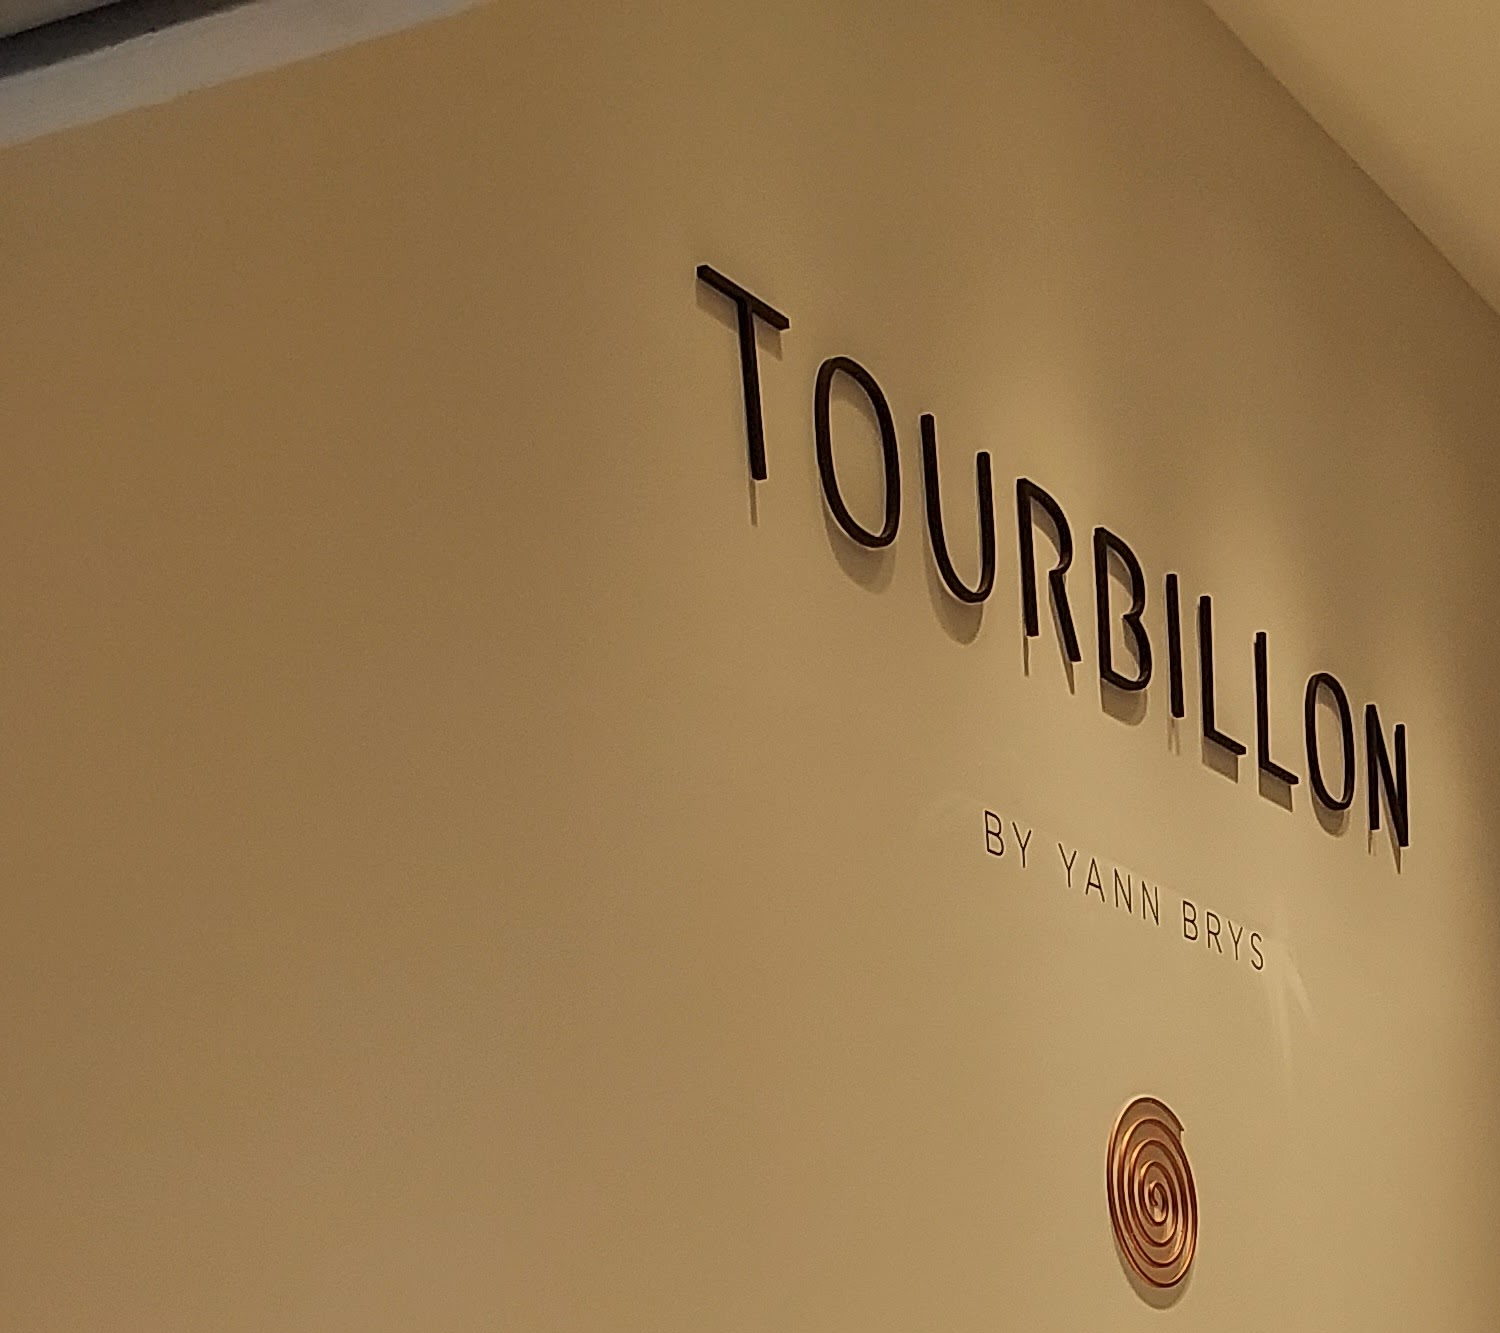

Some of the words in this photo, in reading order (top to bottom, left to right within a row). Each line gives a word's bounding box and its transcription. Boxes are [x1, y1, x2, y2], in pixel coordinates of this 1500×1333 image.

[697, 264, 1410, 848] TOURBILLON
[985, 810, 1032, 868] BY
[1058, 842, 1160, 927] YANN
[1182, 900, 1265, 973] BRYS
